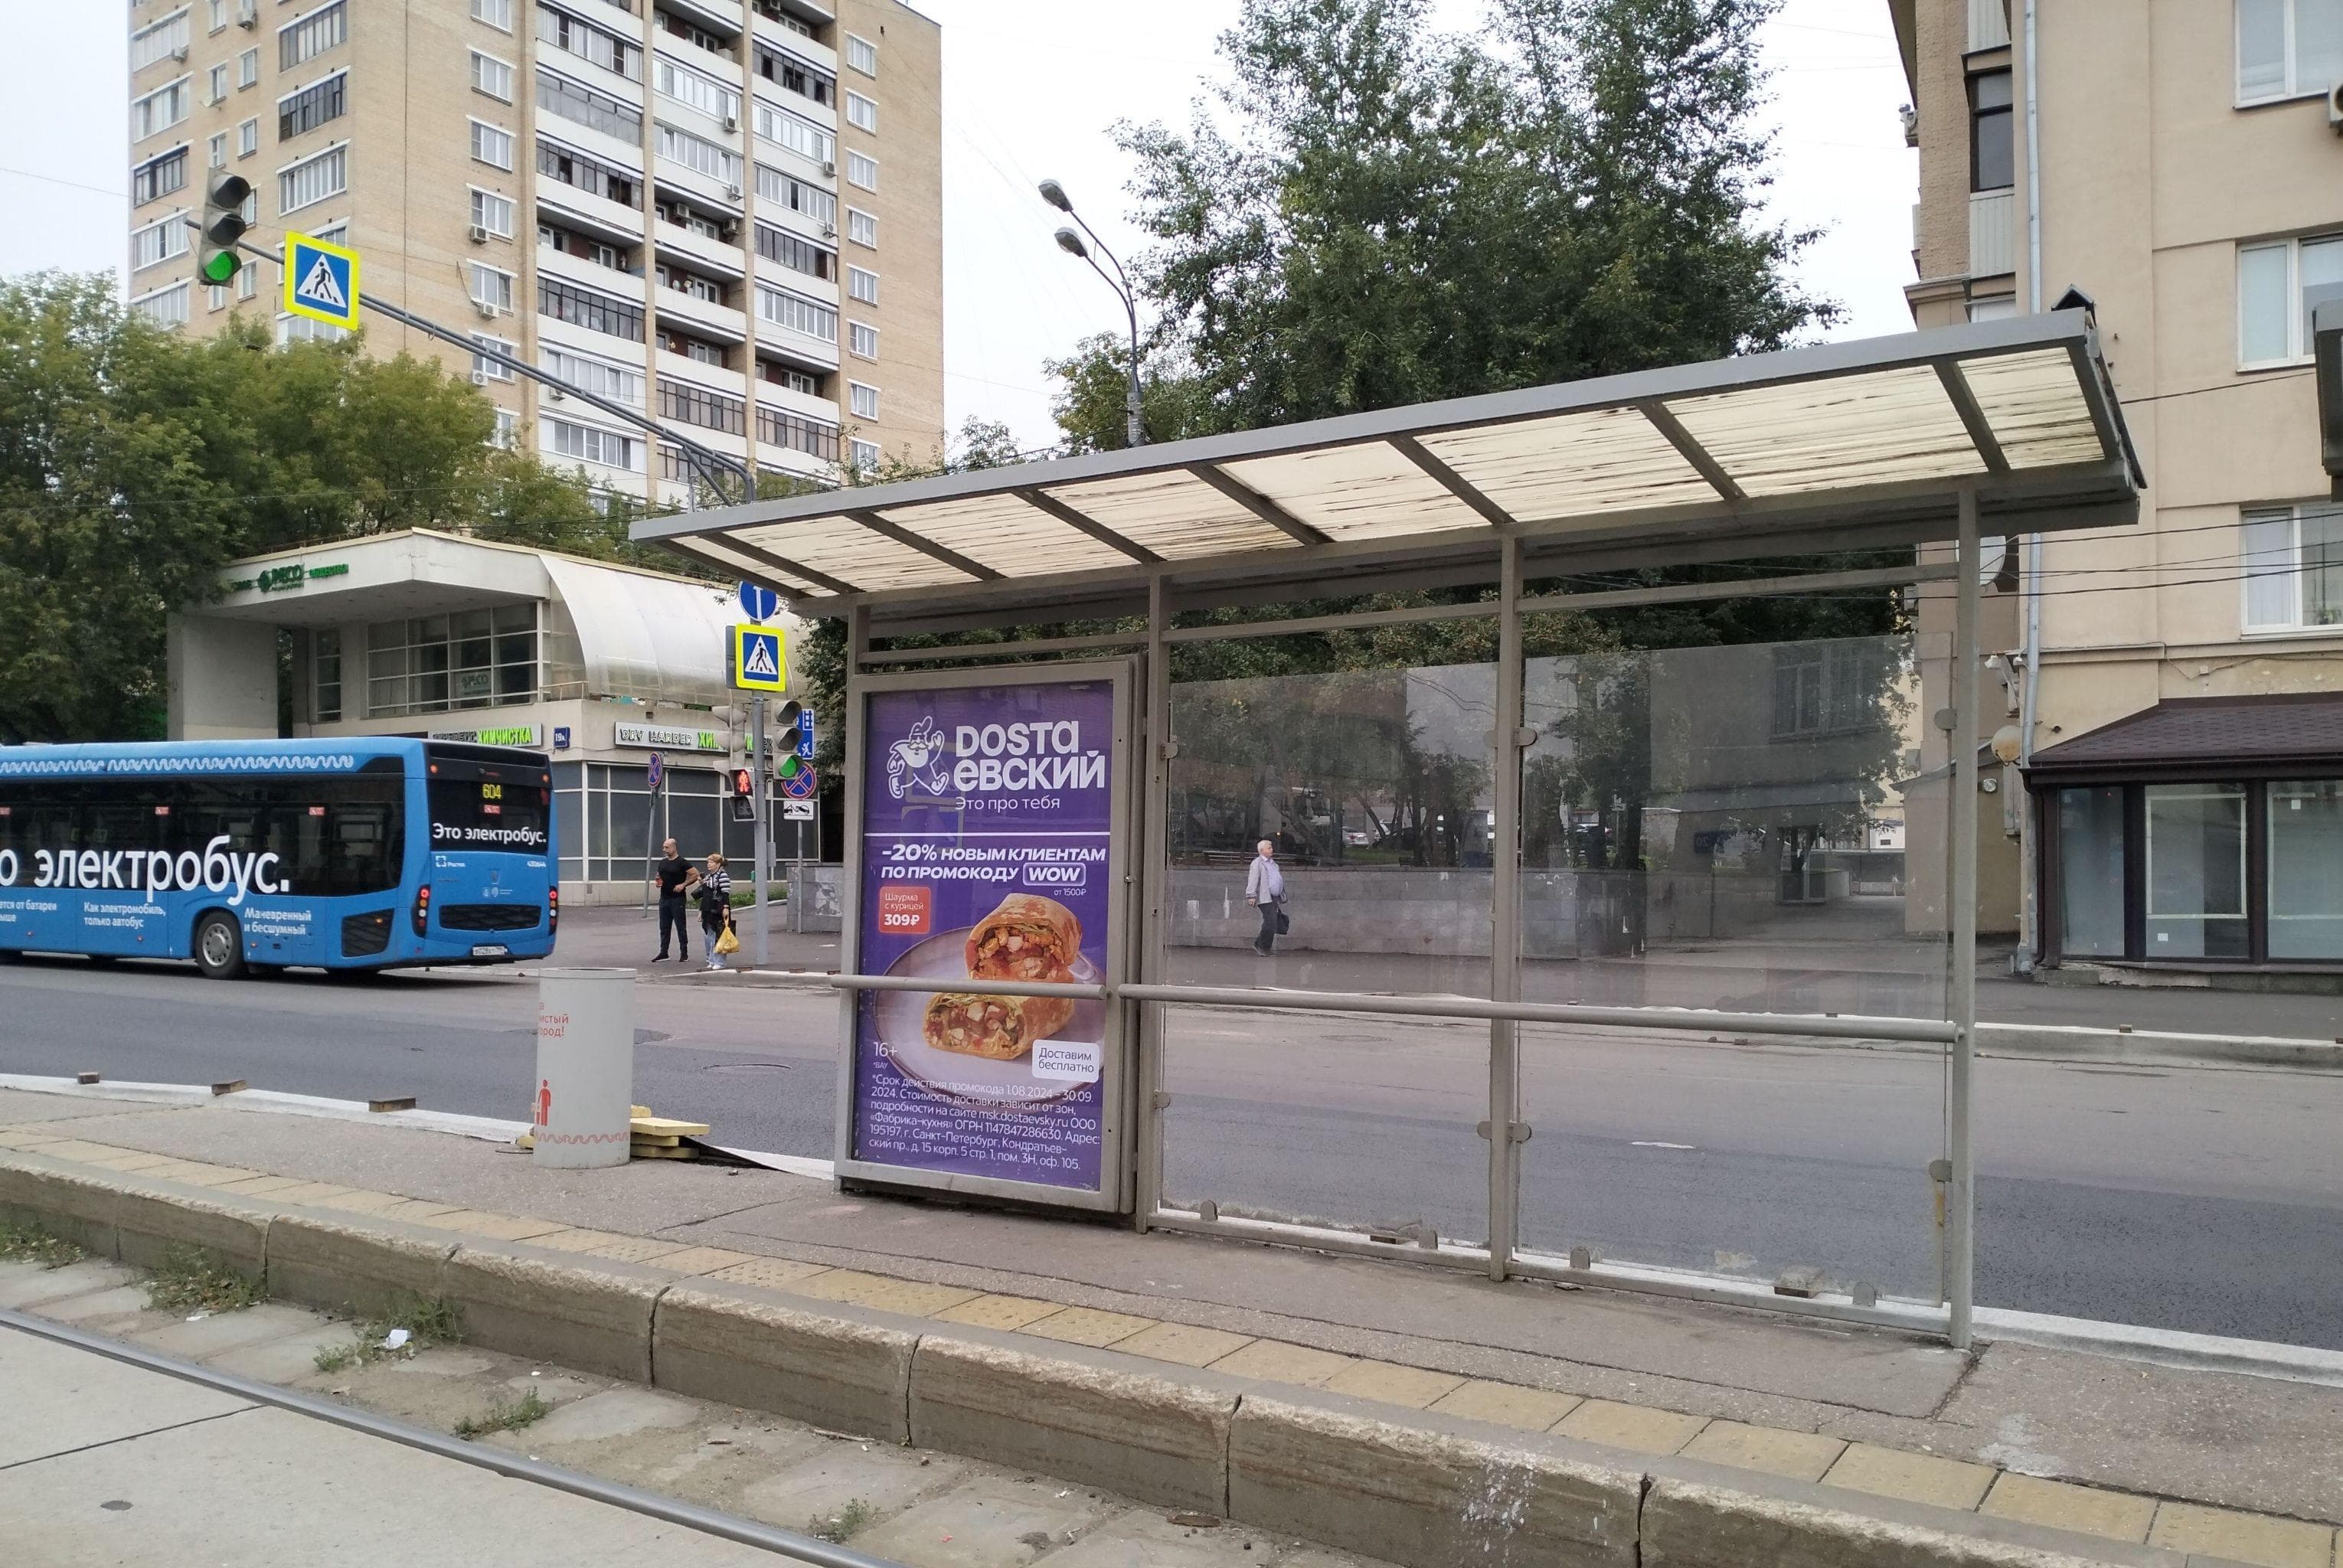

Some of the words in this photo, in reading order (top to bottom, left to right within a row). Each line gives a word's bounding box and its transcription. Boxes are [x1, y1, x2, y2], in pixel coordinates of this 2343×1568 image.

[478, 727, 532, 745] ХИМЧИСТКА
[620, 729, 644, 741] DRY
[649, 731, 693, 745] HARDER
[482, 784, 502, 799] 604
[955, 796, 984, 810] Это
[989, 798, 1018, 813] про
[1021, 794, 1060, 810] тебя
[433, 822, 462, 839] Это
[464, 826, 547, 845] электробус.
[882, 844, 937, 861] -20%
[940, 848, 1006, 861] НОВЫМ
[1008, 848, 1106, 861] КЛИЕНТАМ
[34, 835, 290, 906] электробус.
[881, 866, 906, 879] ПО
[907, 866, 1019, 882] ПРОМОКОДУ
[1028, 867, 1080, 881] WOW
[885, 893, 918, 903] Шаурма
[83, 902, 99, 913] Как
[100, 903, 166, 916] электромобиль,
[244, 906, 312, 922] Маневренный
[890, 903, 923, 911] курицей
[83, 917, 111, 926] только
[112, 916, 144, 929] автобус
[884, 913, 920, 926] 309₽
[243, 923, 250, 932] и
[251, 921, 306, 936] бесшумный
[873, 1041, 897, 1057] 16+
[1039, 1047, 1092, 1061] Доставим
[1038, 1058, 1094, 1073] бесплатно
[902, 1078, 946, 1089] действия
[949, 1083, 1004, 1095] промокода
[871, 1086, 898, 1099] 2024.
[900, 1089, 952, 1103] Стоимость
[953, 1096, 998, 1107] доставки
[1001, 1100, 1040, 1111] зависит
[1042, 1103, 1054, 1112] от
[1055, 1106, 1076, 1116] зон,
[871, 1101, 933, 1113] подробности
[936, 1106, 947, 1116] на
[949, 1107, 977, 1118] сайте
[979, 1109, 1068, 1129] msk.dostaevsky.ru
[1070, 1117, 1096, 1130] ООО
[870, 1124, 902, 1138] 195197,
[913, 1129, 1000, 1147] Санкт-Петербург,
[955, 1119, 983, 1132] ОГРН
[1065, 1131, 1100, 1145] Адрес:
[869, 1138, 891, 1148] ский
[921, 1142, 932, 1152] 15
[933, 1145, 959, 1157] корп.
[961, 1146, 967, 1156] 5
[969, 1149, 988, 1161] стр.
[998, 1152, 1019, 1162] пом.
[1040, 1156, 1060, 1169] оф.
[1062, 1157, 1081, 1170] 105.
